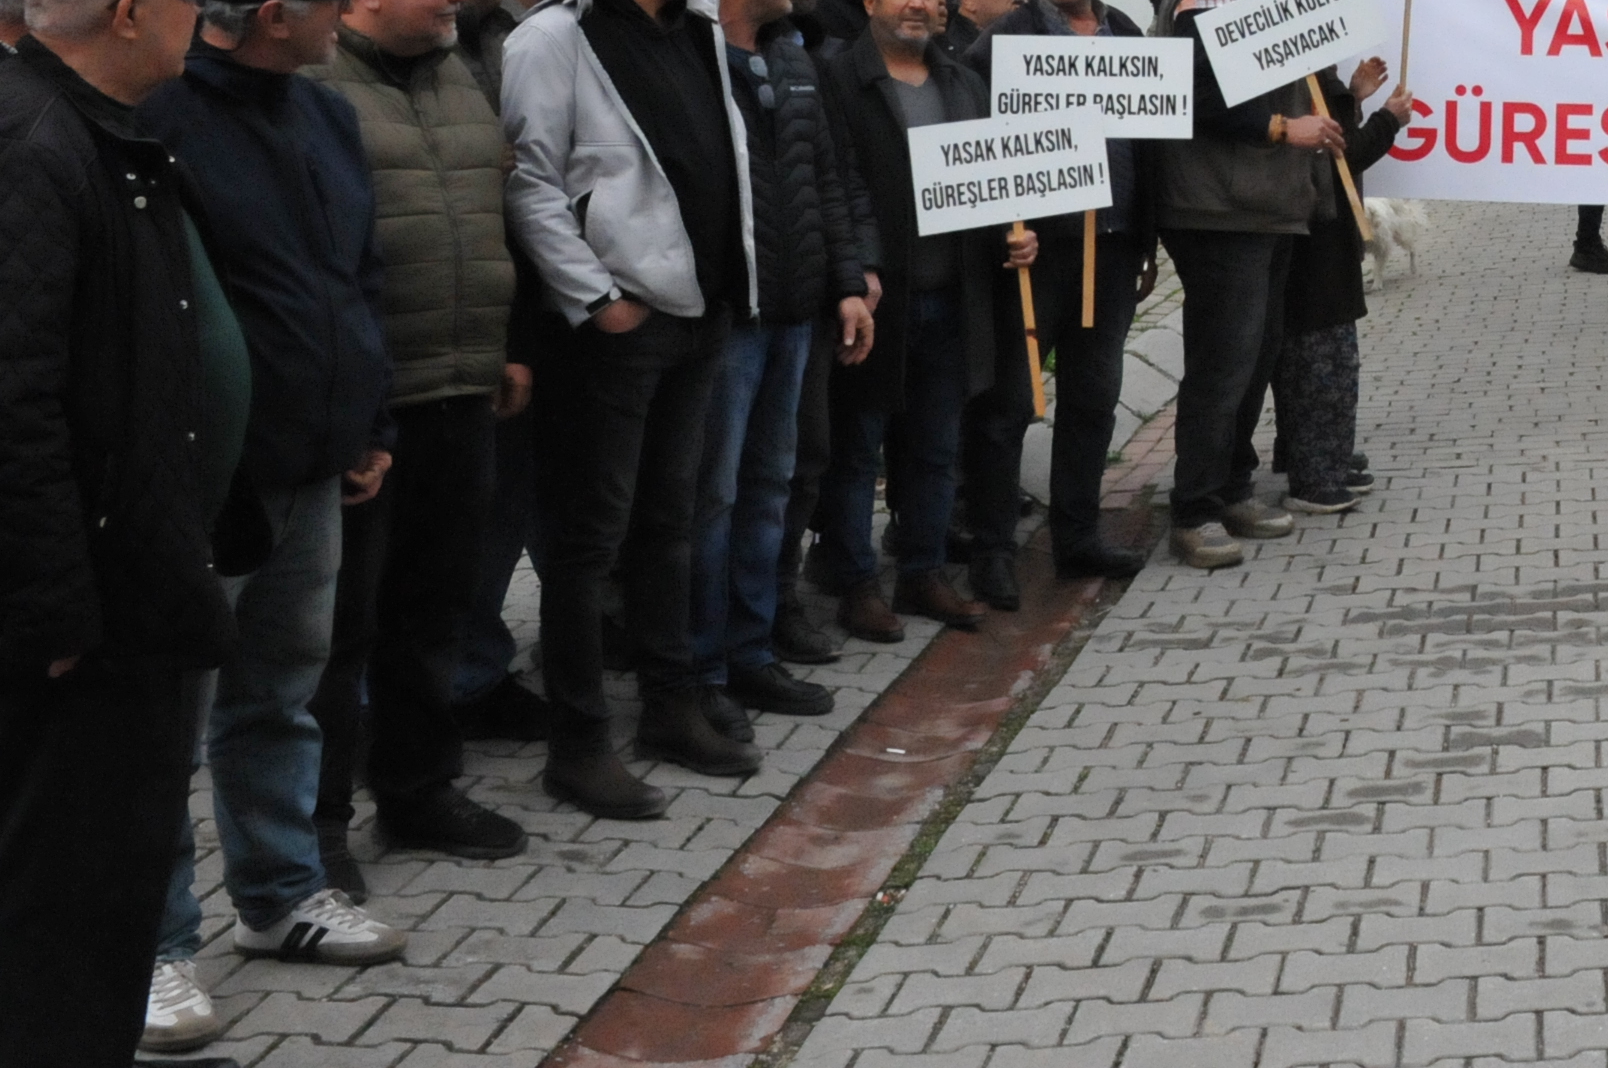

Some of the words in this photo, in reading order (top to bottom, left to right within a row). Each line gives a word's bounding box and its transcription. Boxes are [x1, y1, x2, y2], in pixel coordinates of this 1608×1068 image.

[1214, 0, 1294, 48] DEVECİLİK
[1253, 21, 1339, 71] YAŞAYACAK
[1340, 16, 1349, 37] !
[1022, 53, 1079, 77] YASAK
[1084, 54, 1164, 81] KALKSIN,
[1181, 94, 1187, 116] !
[940, 141, 997, 168] YASAK
[1001, 127, 1079, 159] KALKSIN,
[921, 176, 1009, 212] GÜREŞLER
[1013, 166, 1095, 199] BAŞLASIN
[1098, 162, 1105, 185] !
